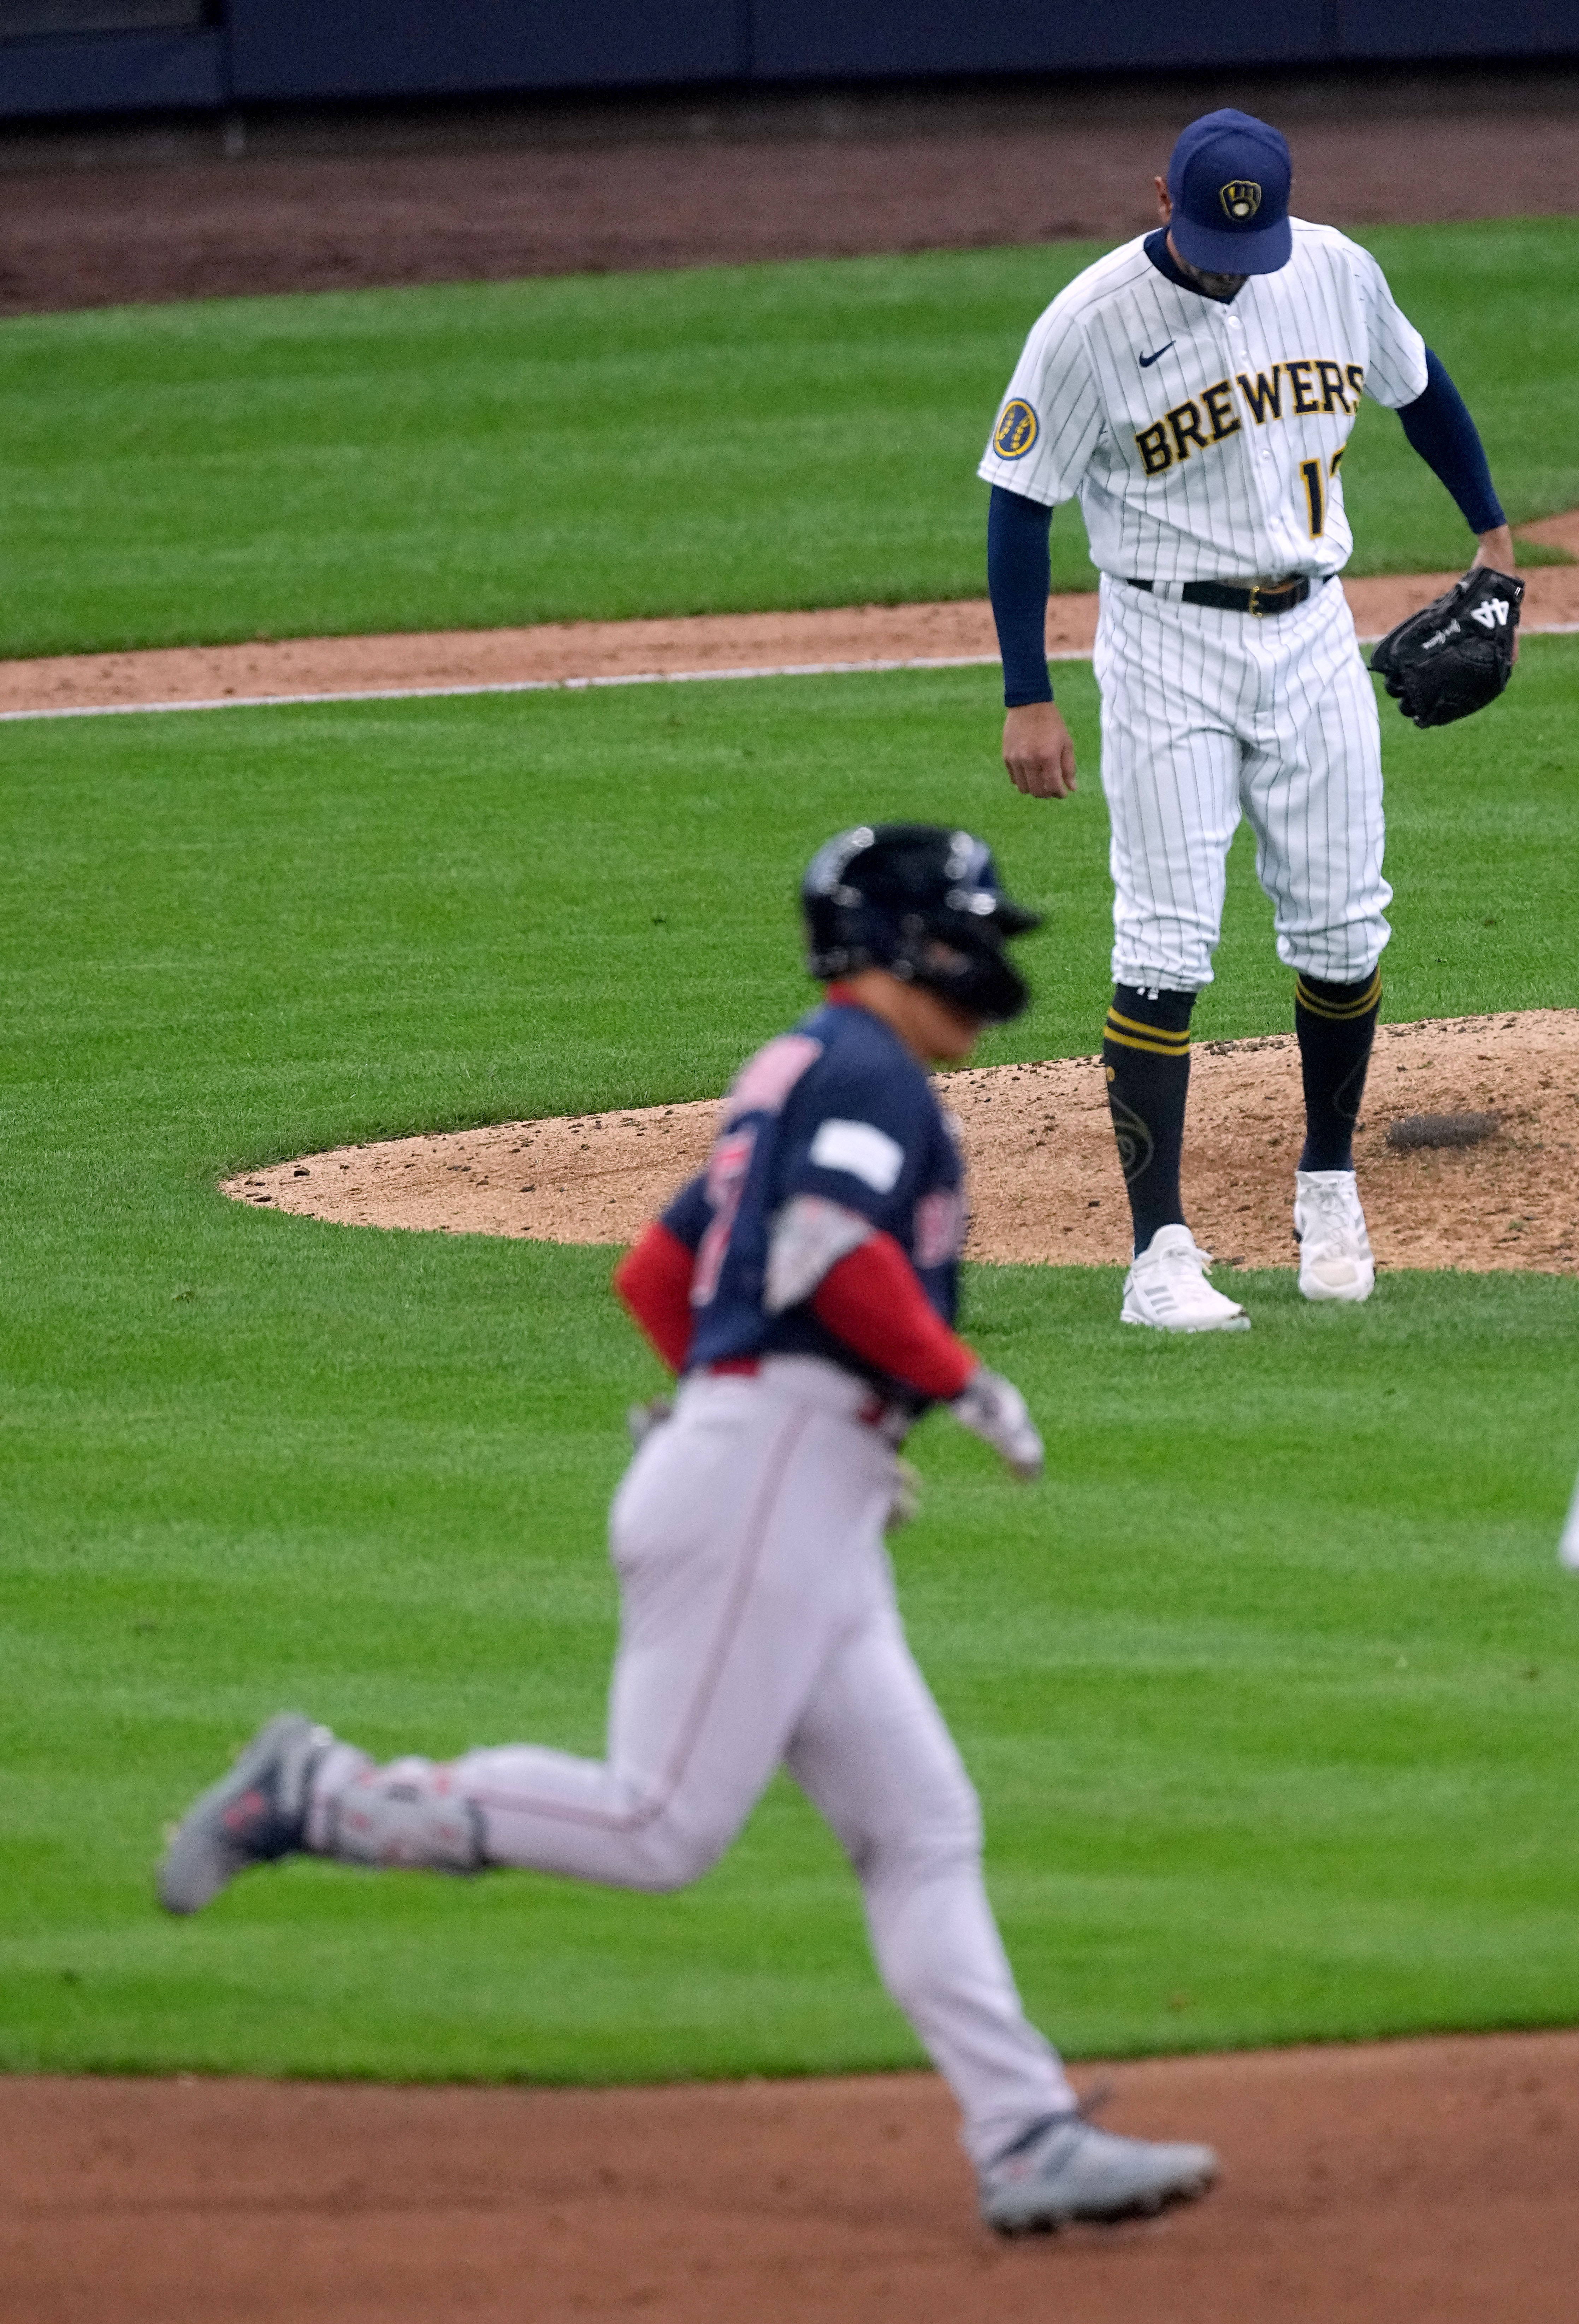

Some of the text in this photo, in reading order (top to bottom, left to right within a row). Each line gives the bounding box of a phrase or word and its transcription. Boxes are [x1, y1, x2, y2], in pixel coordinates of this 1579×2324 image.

[1135, 360, 1365, 476] BREWERS
[1300, 442, 1347, 540] 1
[1471, 598, 1509, 629] 44
